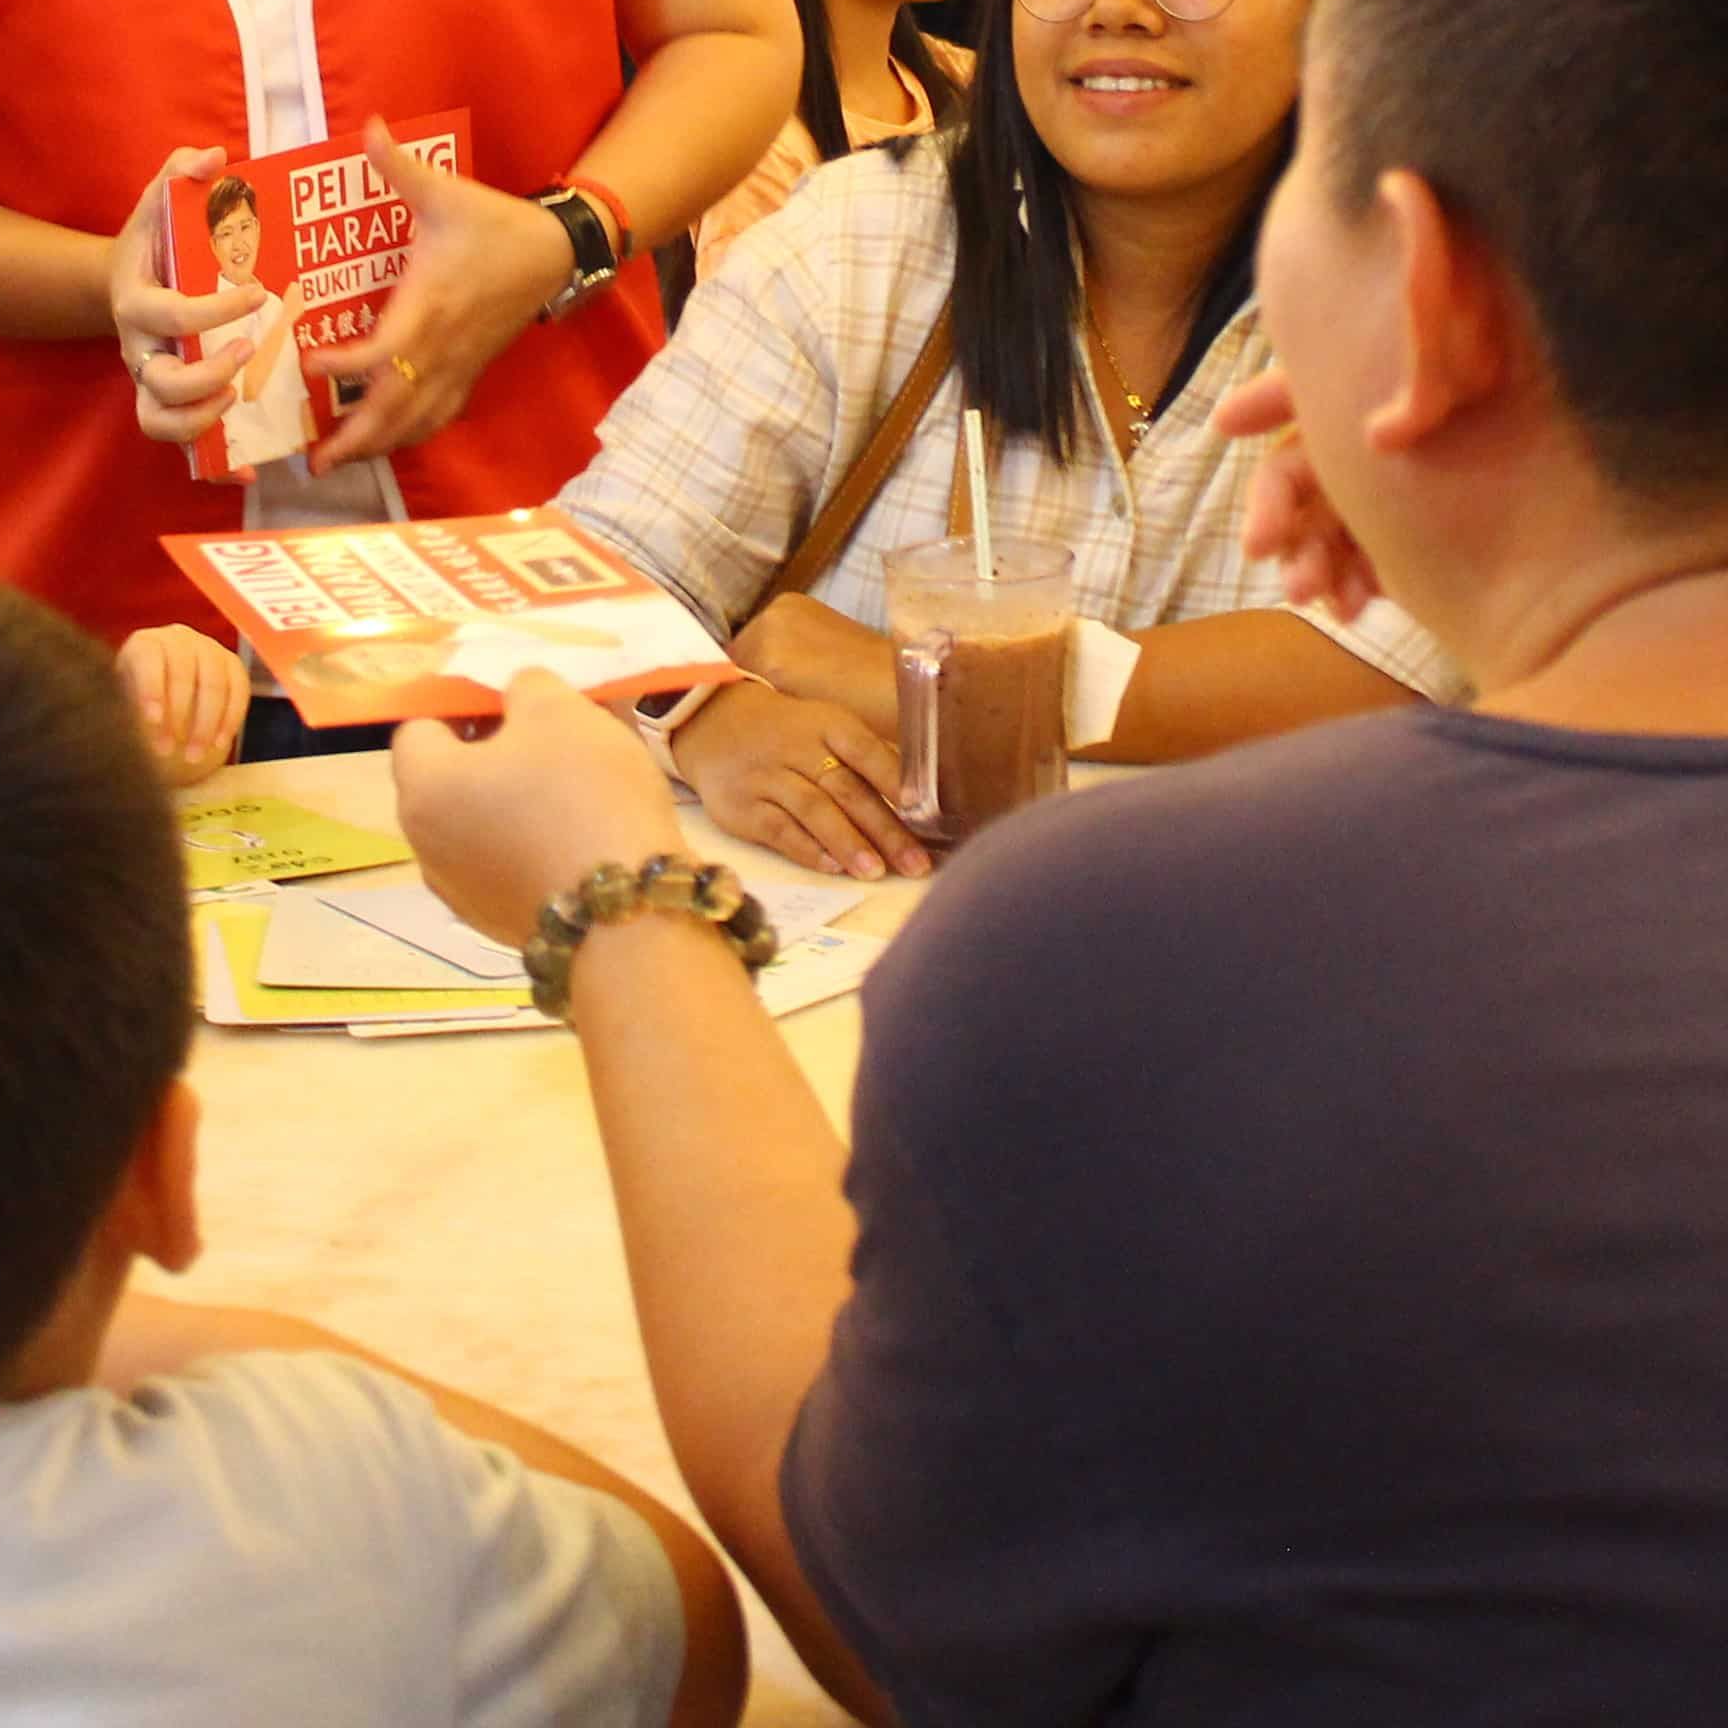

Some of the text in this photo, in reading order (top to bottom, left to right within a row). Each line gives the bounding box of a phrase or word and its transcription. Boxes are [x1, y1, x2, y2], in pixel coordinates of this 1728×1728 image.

[293, 165, 347, 218] PEI
[294, 204, 417, 268] HARAP
[302, 263, 366, 303] BUKIT
[214, 542, 303, 594] LING
